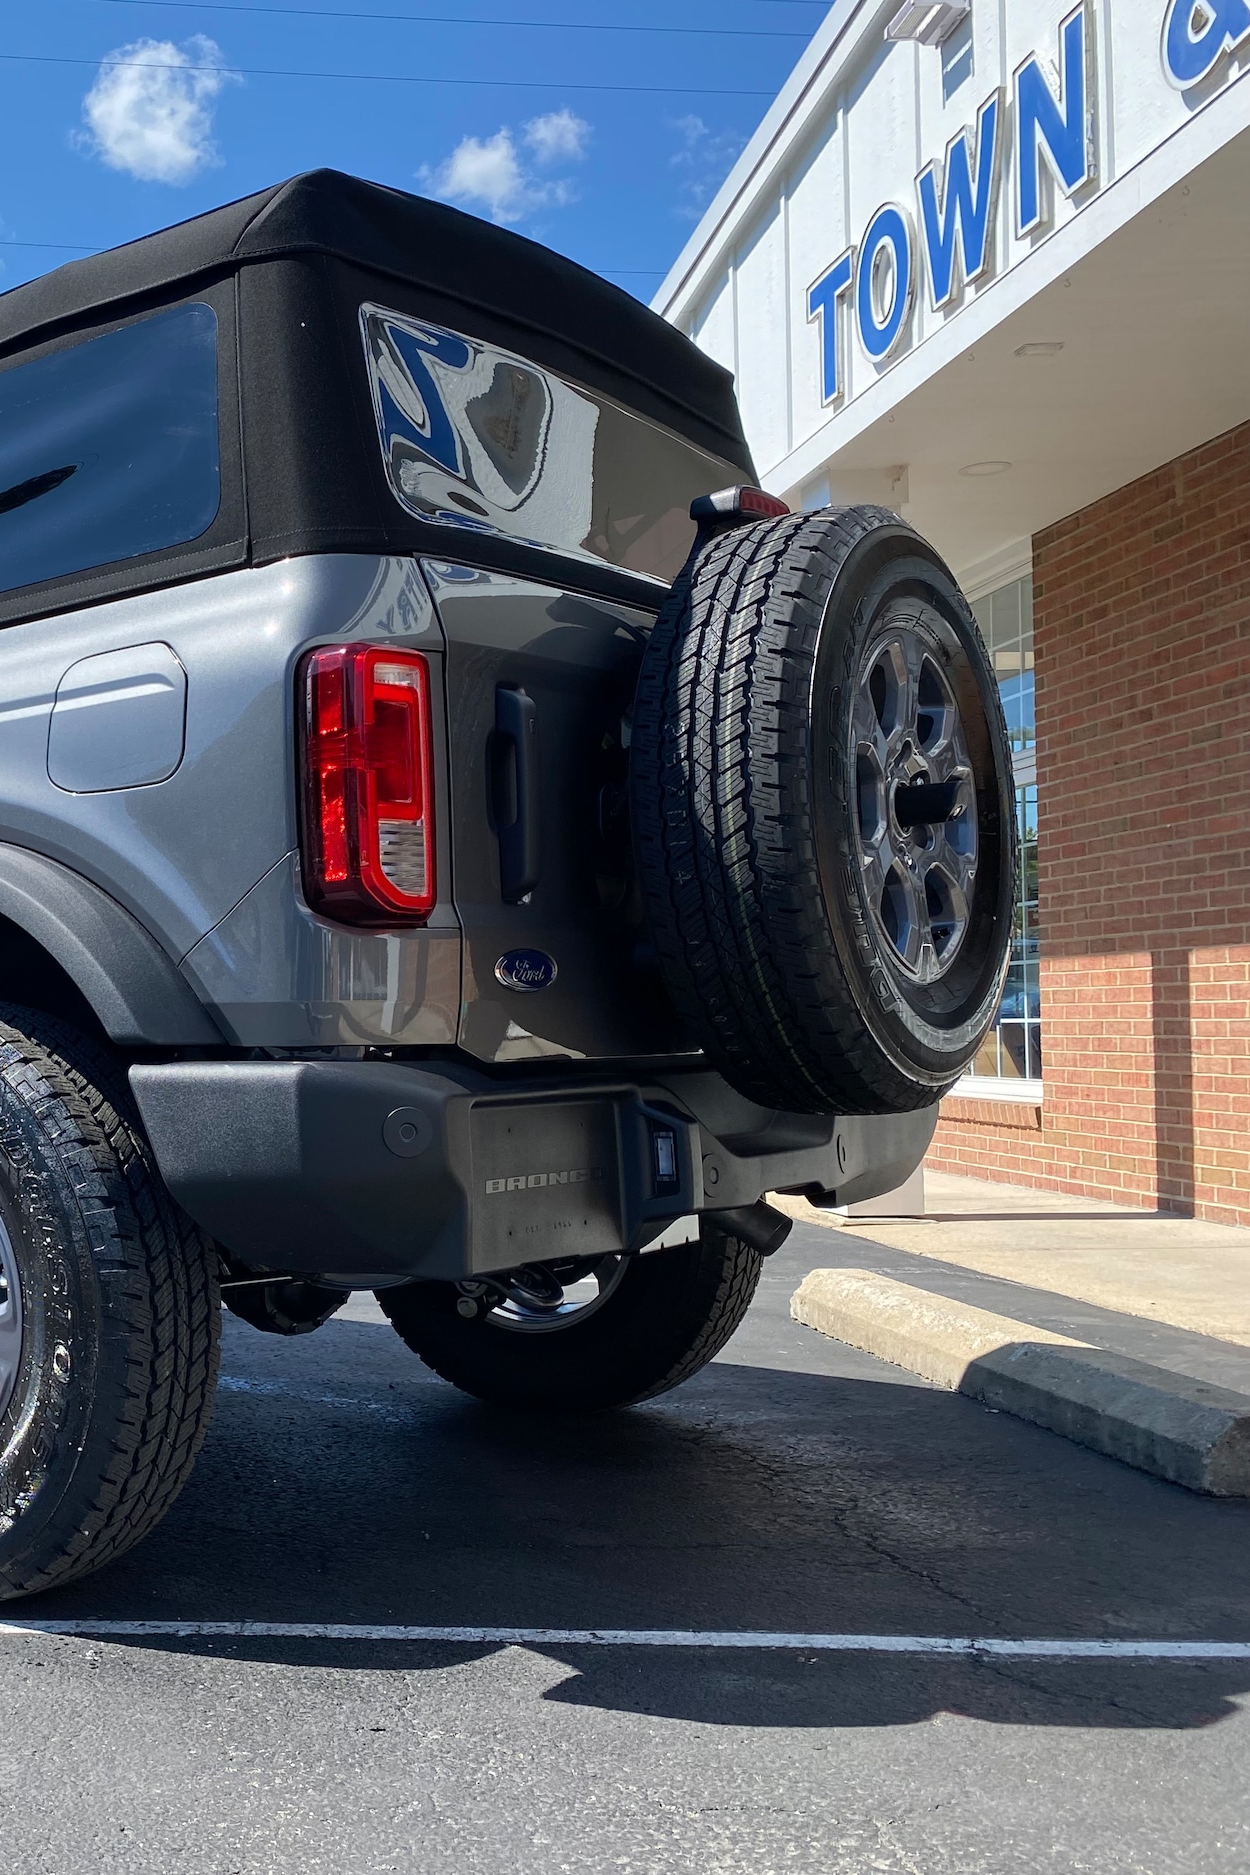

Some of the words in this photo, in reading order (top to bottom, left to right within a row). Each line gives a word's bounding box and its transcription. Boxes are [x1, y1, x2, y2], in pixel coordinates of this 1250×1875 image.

[806, 2, 1097, 408] TOWN
[512, 959, 546, 982] Ford
[485, 1167, 605, 1195] BRONCO
